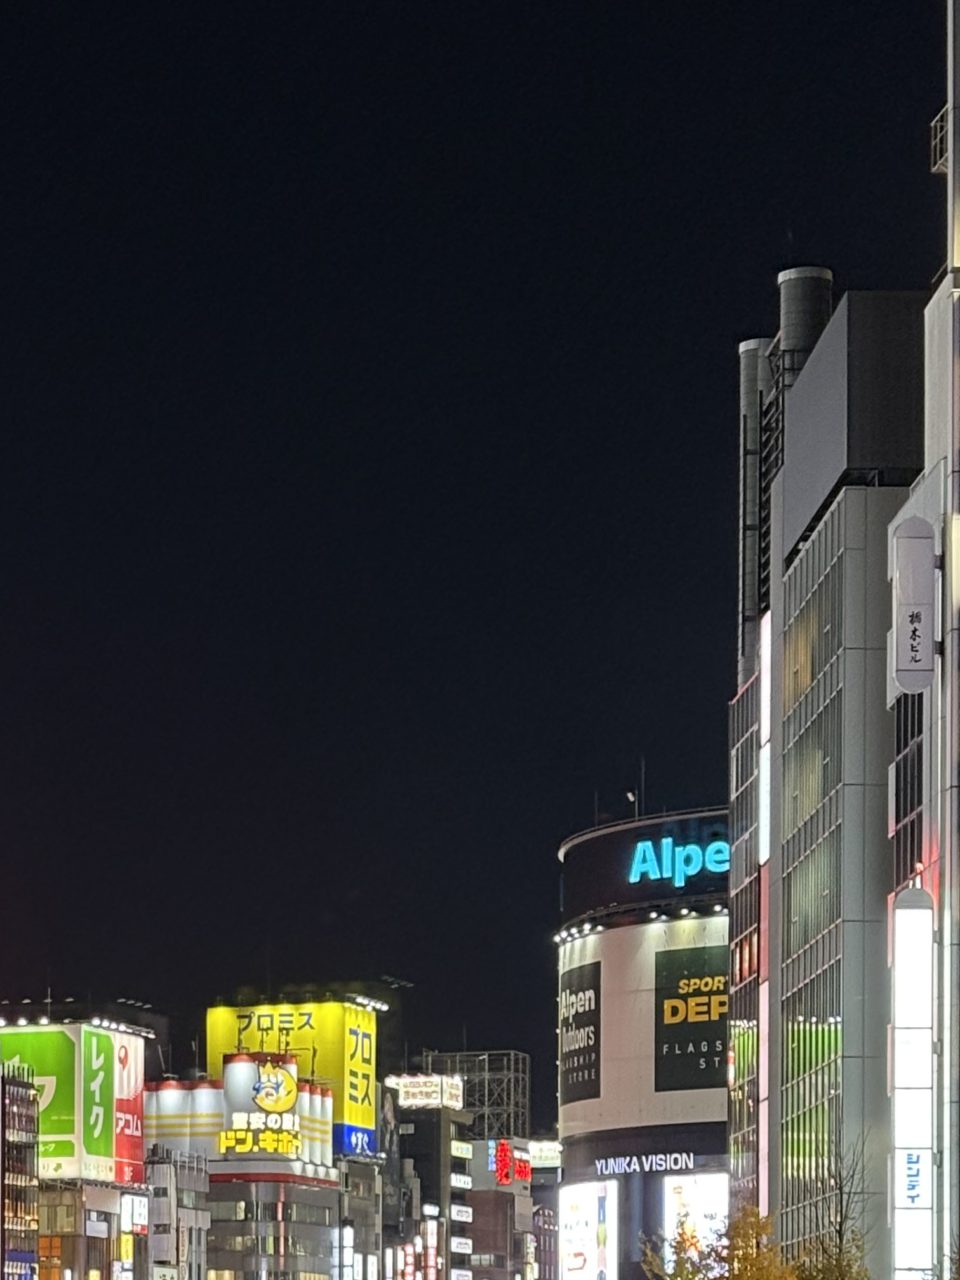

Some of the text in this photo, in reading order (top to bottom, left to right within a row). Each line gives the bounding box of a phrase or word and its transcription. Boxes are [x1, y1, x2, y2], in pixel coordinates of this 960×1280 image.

[629, 837, 730, 888] Alpe
[678, 975, 729, 994] SPOR
[236, 1011, 316, 1032] プロミス
[663, 1041, 723, 1055] FLAGS
[699, 1057, 721, 1069] ST
[90, 1036, 104, 1138] レイク
[116, 1111, 141, 1137] アコム
[595, 1153, 694, 1175] YUNIKA VISION
